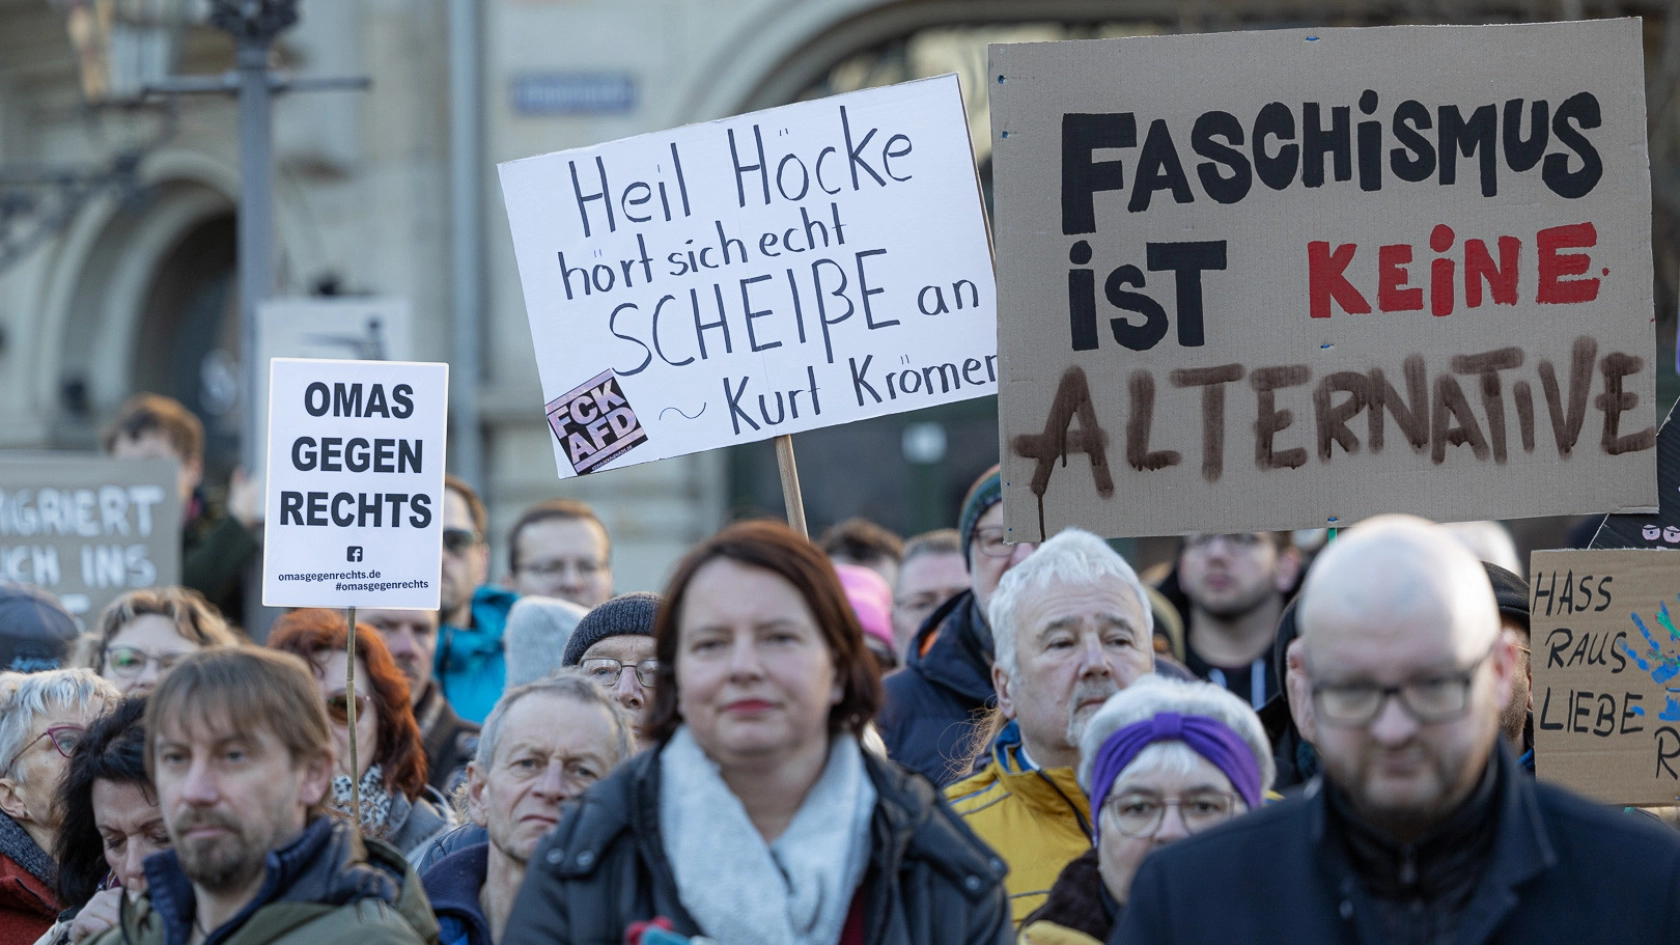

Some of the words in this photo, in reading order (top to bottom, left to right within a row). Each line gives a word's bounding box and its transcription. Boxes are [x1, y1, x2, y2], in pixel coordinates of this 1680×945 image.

[569, 143, 691, 239] Heil
[727, 105, 914, 208] Höcke
[557, 233, 654, 301] hört
[668, 220, 749, 277] sich
[758, 202, 848, 257] echt
[609, 248, 901, 377] SCHEIßE
[917, 279, 980, 316] an
[304, 381, 414, 420] OMAS
[548, 379, 626, 440] FCK
[722, 364, 822, 436] Kurt
[848, 353, 998, 407] Krömer
[291, 436, 423, 474] GEGEN
[567, 406, 638, 465] AFD
[0, 485, 165, 536] IGRIERT
[279, 490, 433, 529] RECHTS
[80, 543, 157, 588] INS
[278, 569, 382, 582] omasgegenrechts.de
[335, 580, 429, 592] #omasgegenrechts
[1531, 569, 1613, 616] HASS
[1544, 628, 1627, 674] RAUS
[1539, 687, 1644, 738] LIEBE
